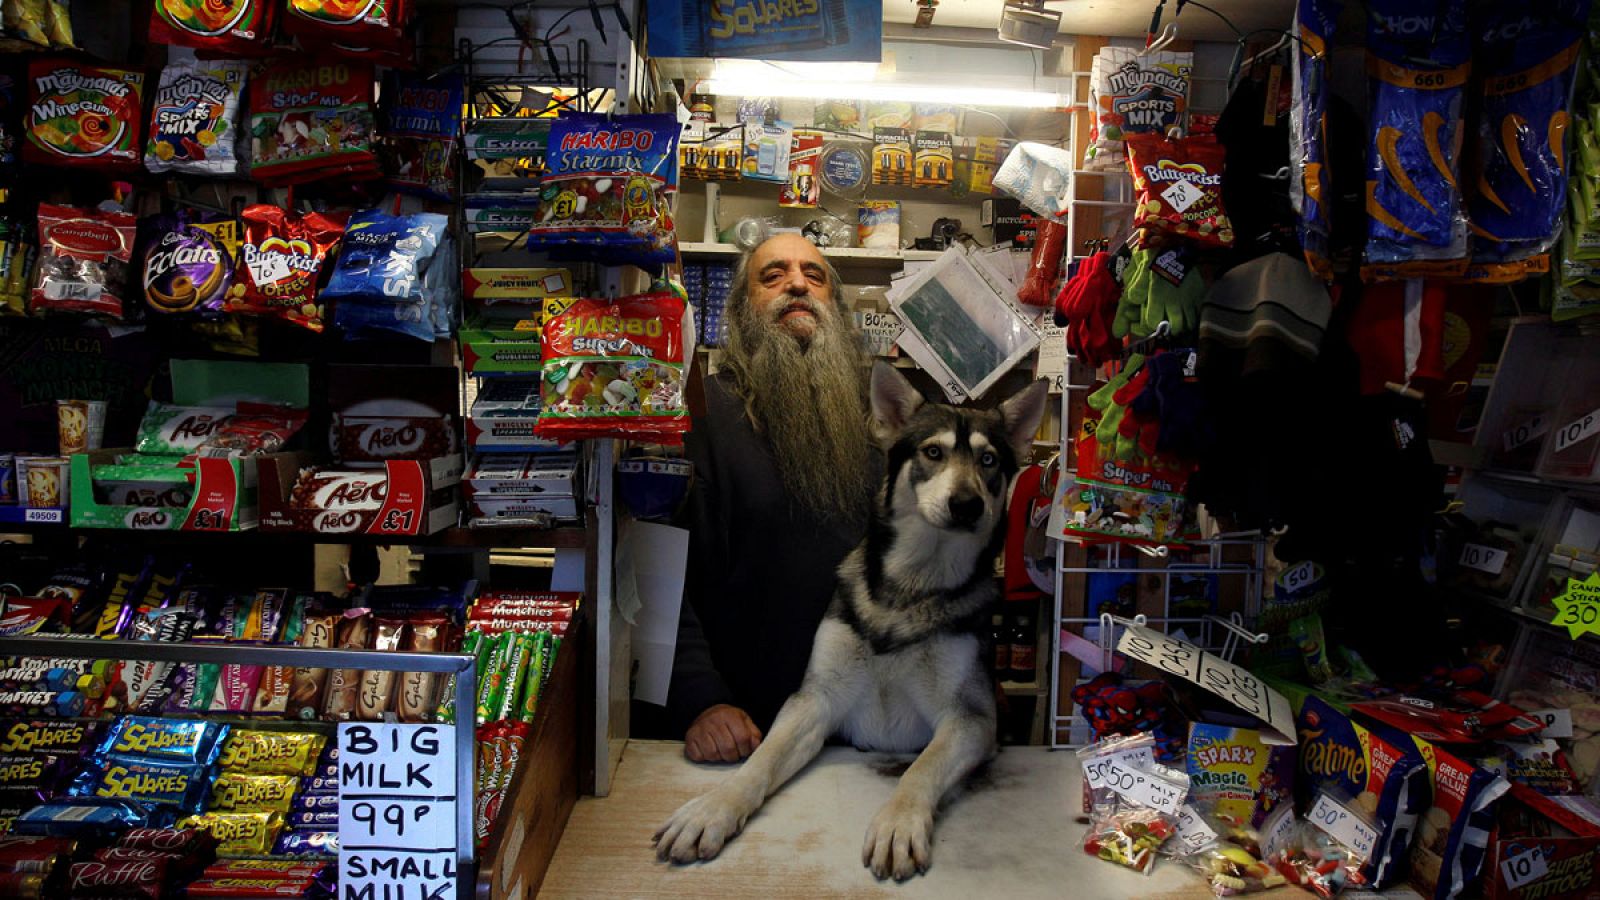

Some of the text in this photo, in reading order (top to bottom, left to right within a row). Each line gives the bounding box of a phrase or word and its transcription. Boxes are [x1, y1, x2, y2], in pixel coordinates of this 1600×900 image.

[36, 74, 129, 97] Maynards
[265, 63, 349, 90] HARIBO
[1109, 70, 1187, 96] Maynards
[1415, 74, 1444, 87] 660
[1119, 99, 1175, 113] SPORTS
[164, 120, 201, 134] MIX
[1129, 111, 1165, 126] MIX
[486, 138, 539, 153] Extra
[560, 130, 653, 152] HARIBO
[875, 134, 908, 142] DURACELL
[917, 139, 951, 147] DURACELL
[560, 151, 642, 171] Starmix
[1144, 164, 1221, 186] Butterkist
[556, 201, 573, 214] £1
[52, 227, 117, 246] Campbell's
[215, 224, 232, 241] £1
[145, 246, 221, 290] Eclairs
[492, 280, 539, 288] JUICY FRUIT
[564, 315, 662, 337] HARIBO
[43, 336, 102, 353] MEGA
[572, 337, 627, 353] Super
[169, 415, 218, 442] Aer
[368, 424, 417, 452] Aero
[1559, 416, 1592, 447] 10P
[1104, 461, 1152, 484] Super
[324, 480, 388, 507] Aero
[1151, 479, 1173, 492] Mix
[29, 511, 57, 521] 49509
[131, 511, 167, 528] Aero
[194, 508, 225, 528] £1
[319, 511, 356, 531] Aero
[380, 508, 414, 531] £1
[1464, 548, 1495, 565] 10P
[492, 605, 553, 617] Munchies
[1564, 604, 1598, 625] 30
[491, 618, 553, 630] Munchies
[1127, 637, 1197, 678] NO CASH
[131, 661, 147, 692] eno
[0, 691, 57, 705] ARTIES
[362, 669, 381, 709] Gala
[404, 672, 423, 709] Gala
[1206, 668, 1260, 714] NO CIGS
[0, 722, 85, 753] SQUARES
[344, 725, 439, 756] BIG
[219, 736, 298, 766] SQUARES
[1197, 746, 1256, 767] SPARX
[1299, 727, 1364, 784] Teatime
[0, 761, 44, 782] ARES
[95, 766, 189, 798] SQUARES
[342, 760, 433, 789] MILK
[1191, 771, 1248, 786] Magic
[1439, 762, 1470, 783] GREAT
[1150, 783, 1176, 799] MIX
[1435, 771, 1468, 796] VALUE
[209, 779, 286, 810] SQUARES
[1151, 795, 1170, 807] UP
[1315, 801, 1373, 842] 50P MIX
[1353, 838, 1367, 851] UP
[347, 855, 456, 880] SMALL
[1508, 850, 1540, 882] 10P
[1546, 850, 1594, 878] SUPER
[1520, 868, 1594, 899] TATTOOS
